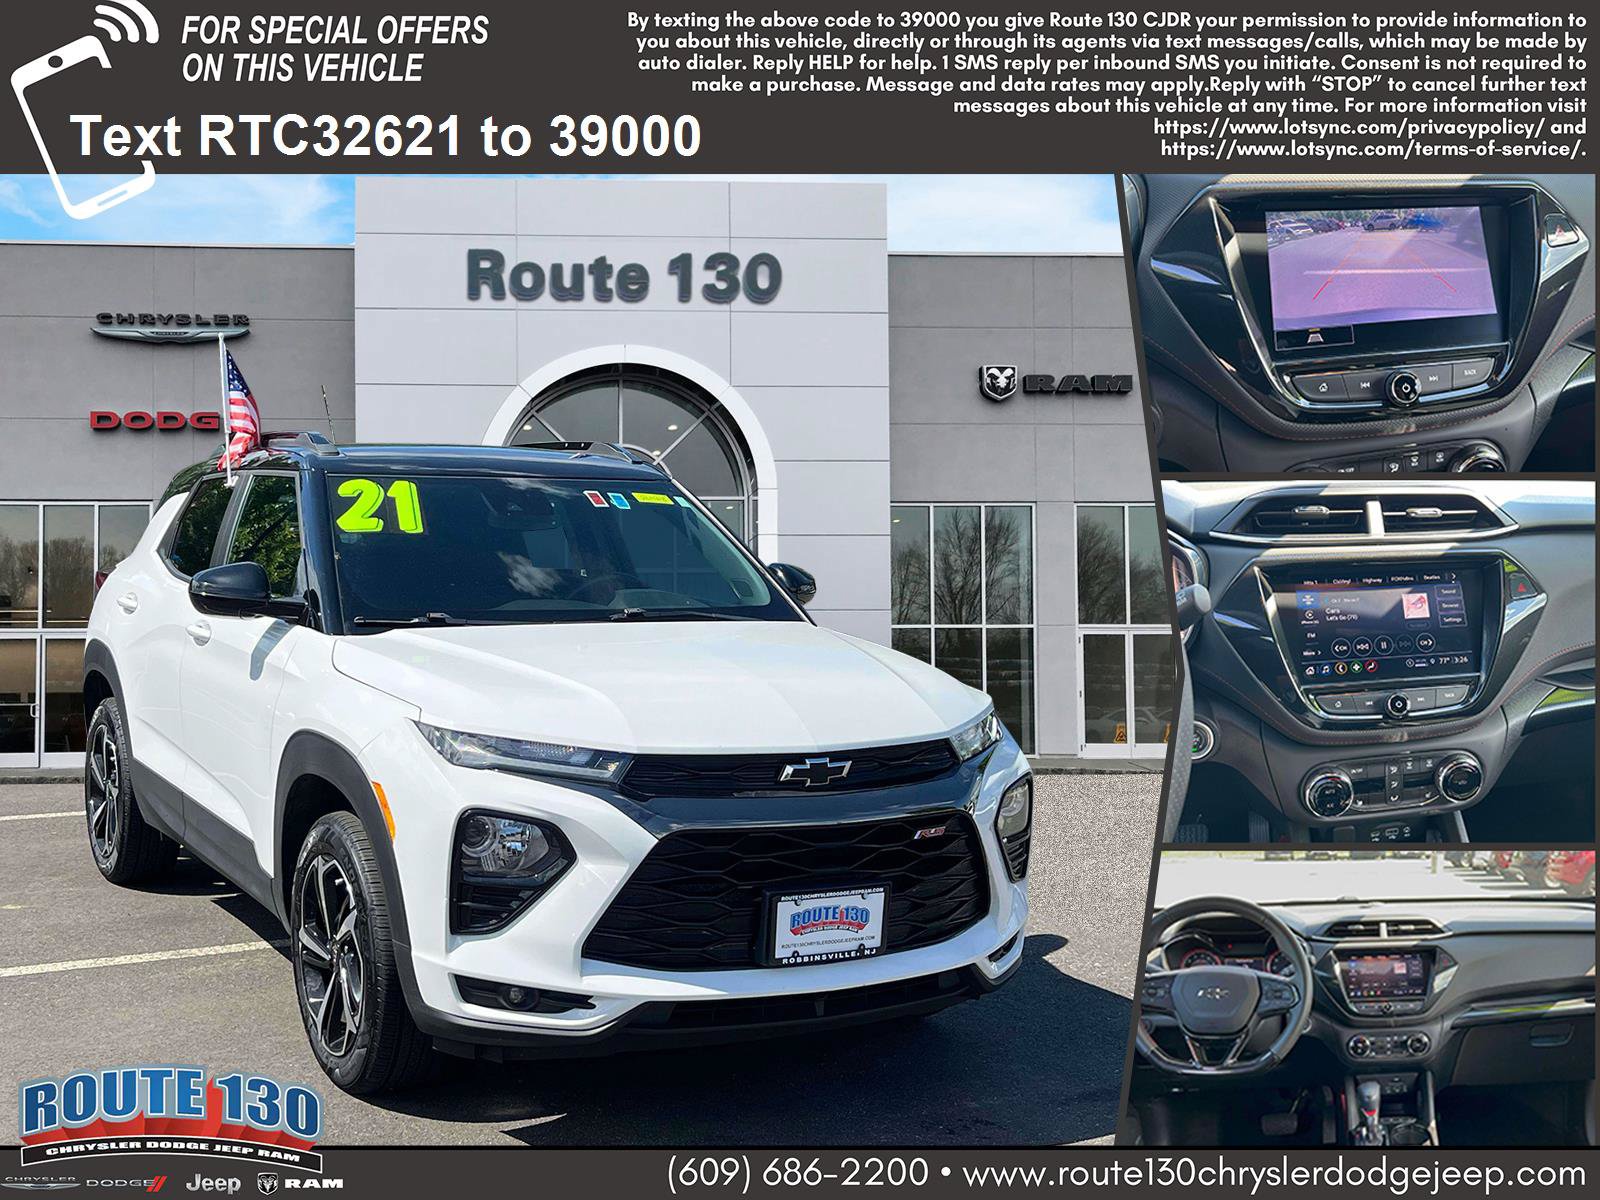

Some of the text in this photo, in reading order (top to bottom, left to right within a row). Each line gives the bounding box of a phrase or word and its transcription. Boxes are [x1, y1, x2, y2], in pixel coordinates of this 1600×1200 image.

[467, 249, 783, 304] Route 130
[96, 312, 250, 326] CHRYSLER
[1023, 375, 1133, 394] RAM
[90, 411, 221, 432] DODG
[336, 478, 424, 534] 21
[791, 905, 870, 929] ROUTE 130
[864, 948, 877, 956] NJ
